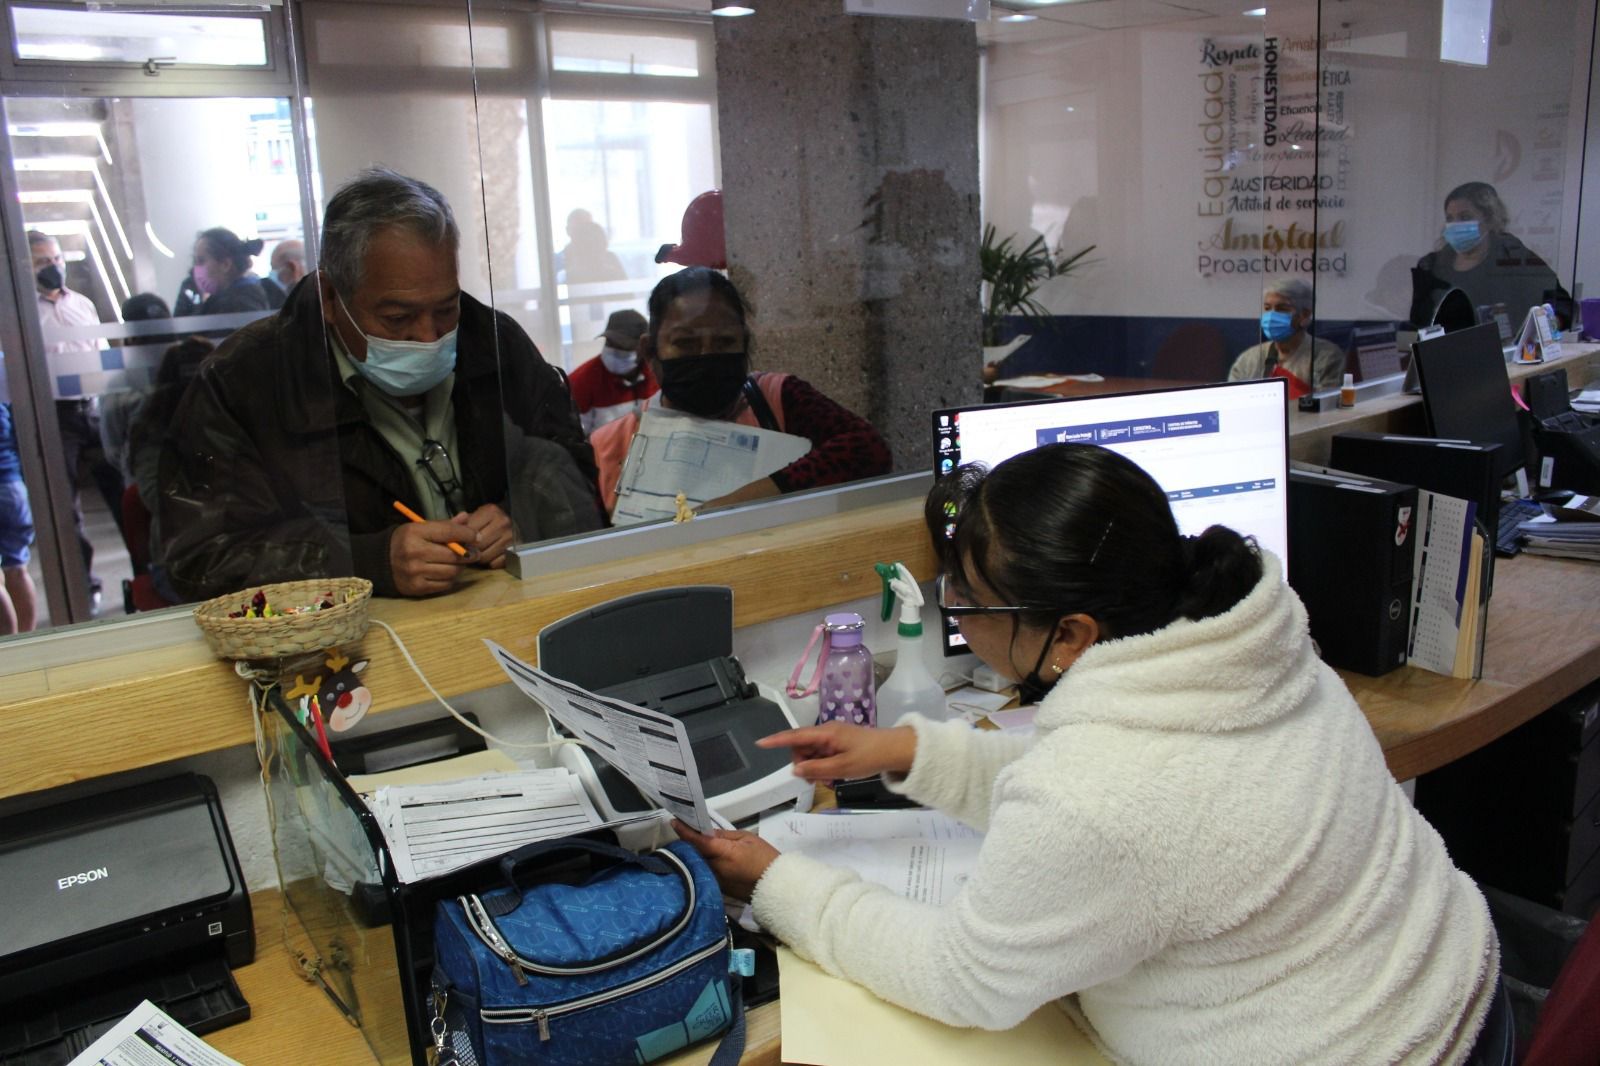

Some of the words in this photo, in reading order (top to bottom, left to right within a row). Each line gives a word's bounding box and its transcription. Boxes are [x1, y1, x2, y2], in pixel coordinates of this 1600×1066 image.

[1201, 38, 1261, 67] Respeto
[1323, 66, 1351, 87] ÉTICA
[1264, 37, 1278, 147] HONESTIDAD
[1198, 71, 1230, 217] Equidad
[1230, 175, 1333, 193] AUSTERIDAD
[1276, 196, 1289, 211] de
[1297, 196, 1345, 209] servicio
[1198, 217, 1346, 254] Amistad
[1198, 253, 1347, 273] Proactividad
[58, 866, 108, 889] EPSON
